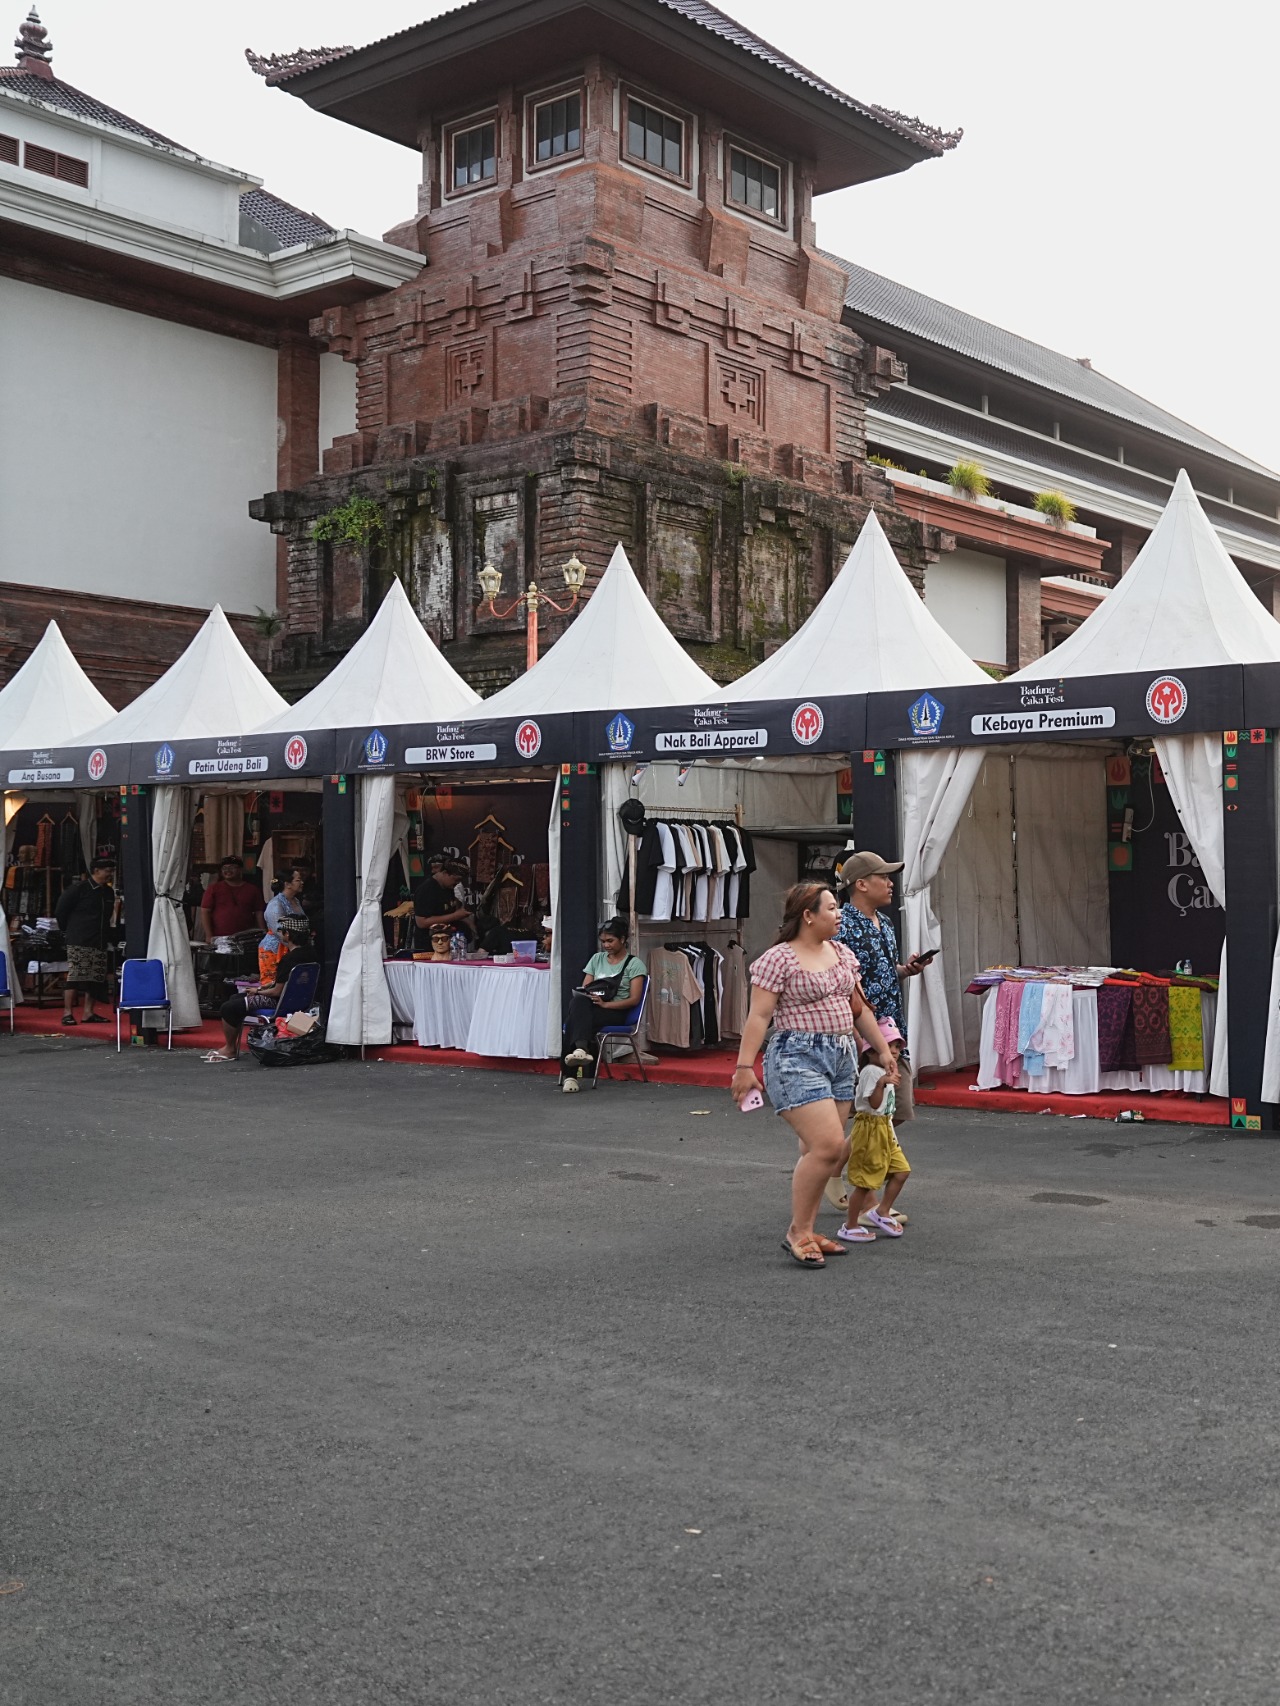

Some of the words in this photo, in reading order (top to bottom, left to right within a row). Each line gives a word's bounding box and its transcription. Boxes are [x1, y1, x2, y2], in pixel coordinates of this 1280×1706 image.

[1021, 685, 1056, 697] Badung
[1045, 693, 1065, 704] Fest
[694, 708, 722, 718] Badung
[713, 716, 729, 725] Fest
[982, 715, 1034, 733] Kebaya
[1039, 712, 1104, 729] Premium
[664, 734, 686, 748] Nak
[690, 732, 711, 747] Bali
[714, 731, 759, 750] Apparel
[426, 748, 447, 761] BRW
[450, 747, 475, 760] Store
[195, 761, 215, 773] Patin
[217, 760, 244, 773] Udeng
[246, 758, 262, 770] Bali
[21, 771, 35, 783] Ang
[36, 770, 61, 781] Busana
